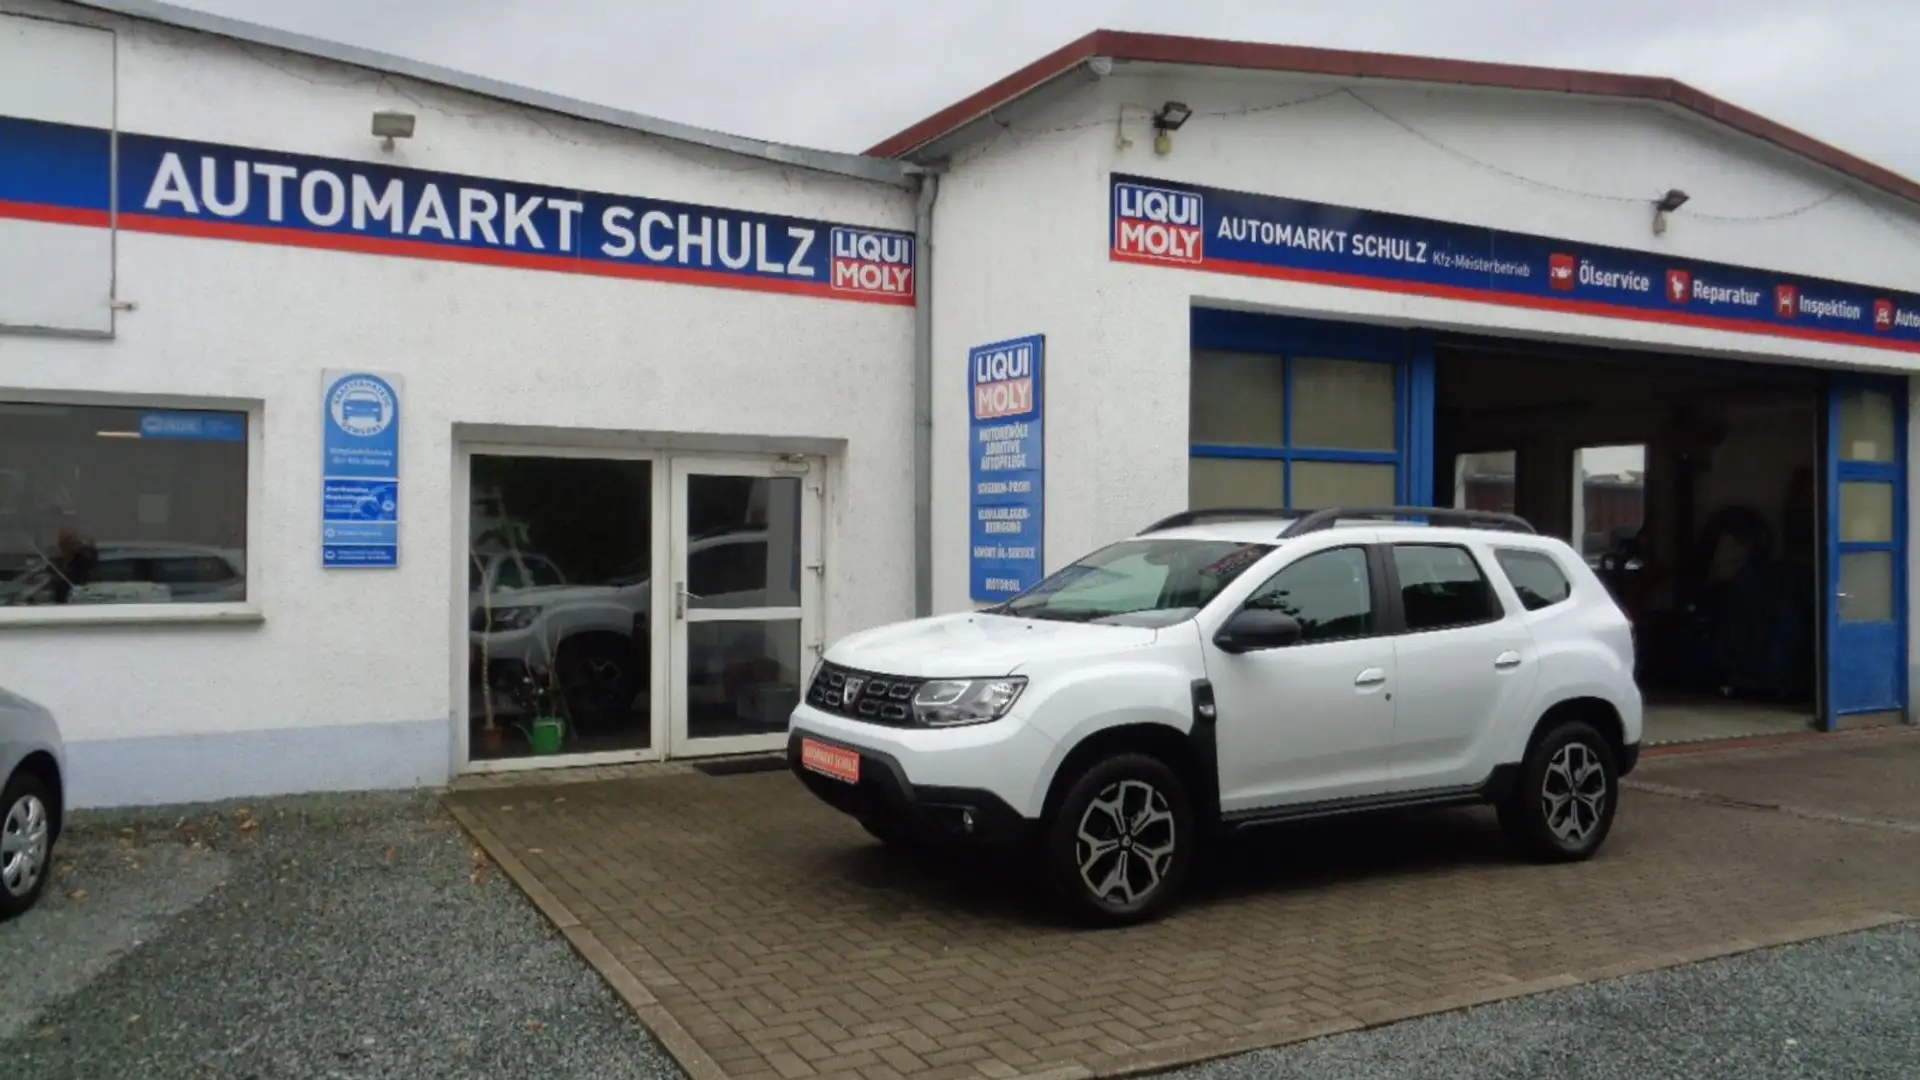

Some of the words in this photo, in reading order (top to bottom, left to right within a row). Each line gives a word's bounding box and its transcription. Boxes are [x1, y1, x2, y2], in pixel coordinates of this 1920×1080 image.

[144, 152, 584, 252] AUTOMARKT
[601, 205, 815, 277] SCHULZ
[1120, 188, 1198, 226] LIQUI
[835, 231, 909, 264] LIQUI
[1120, 221, 1200, 258] MOLY
[1217, 216, 1347, 253] AUTOMARKT
[1351, 234, 1427, 264] SCHULZ
[1432, 251, 1531, 277] Kfz-Meisterbetrieb
[836, 261, 911, 293] MOLY
[1578, 259, 1650, 292] Ölservice
[1692, 279, 1761, 306] Reparatur
[1799, 293, 1861, 320] Inspektion
[1894, 308, 1920, 333] Auto
[977, 347, 1029, 384] LIQUI
[977, 378, 1030, 415] MOLY
